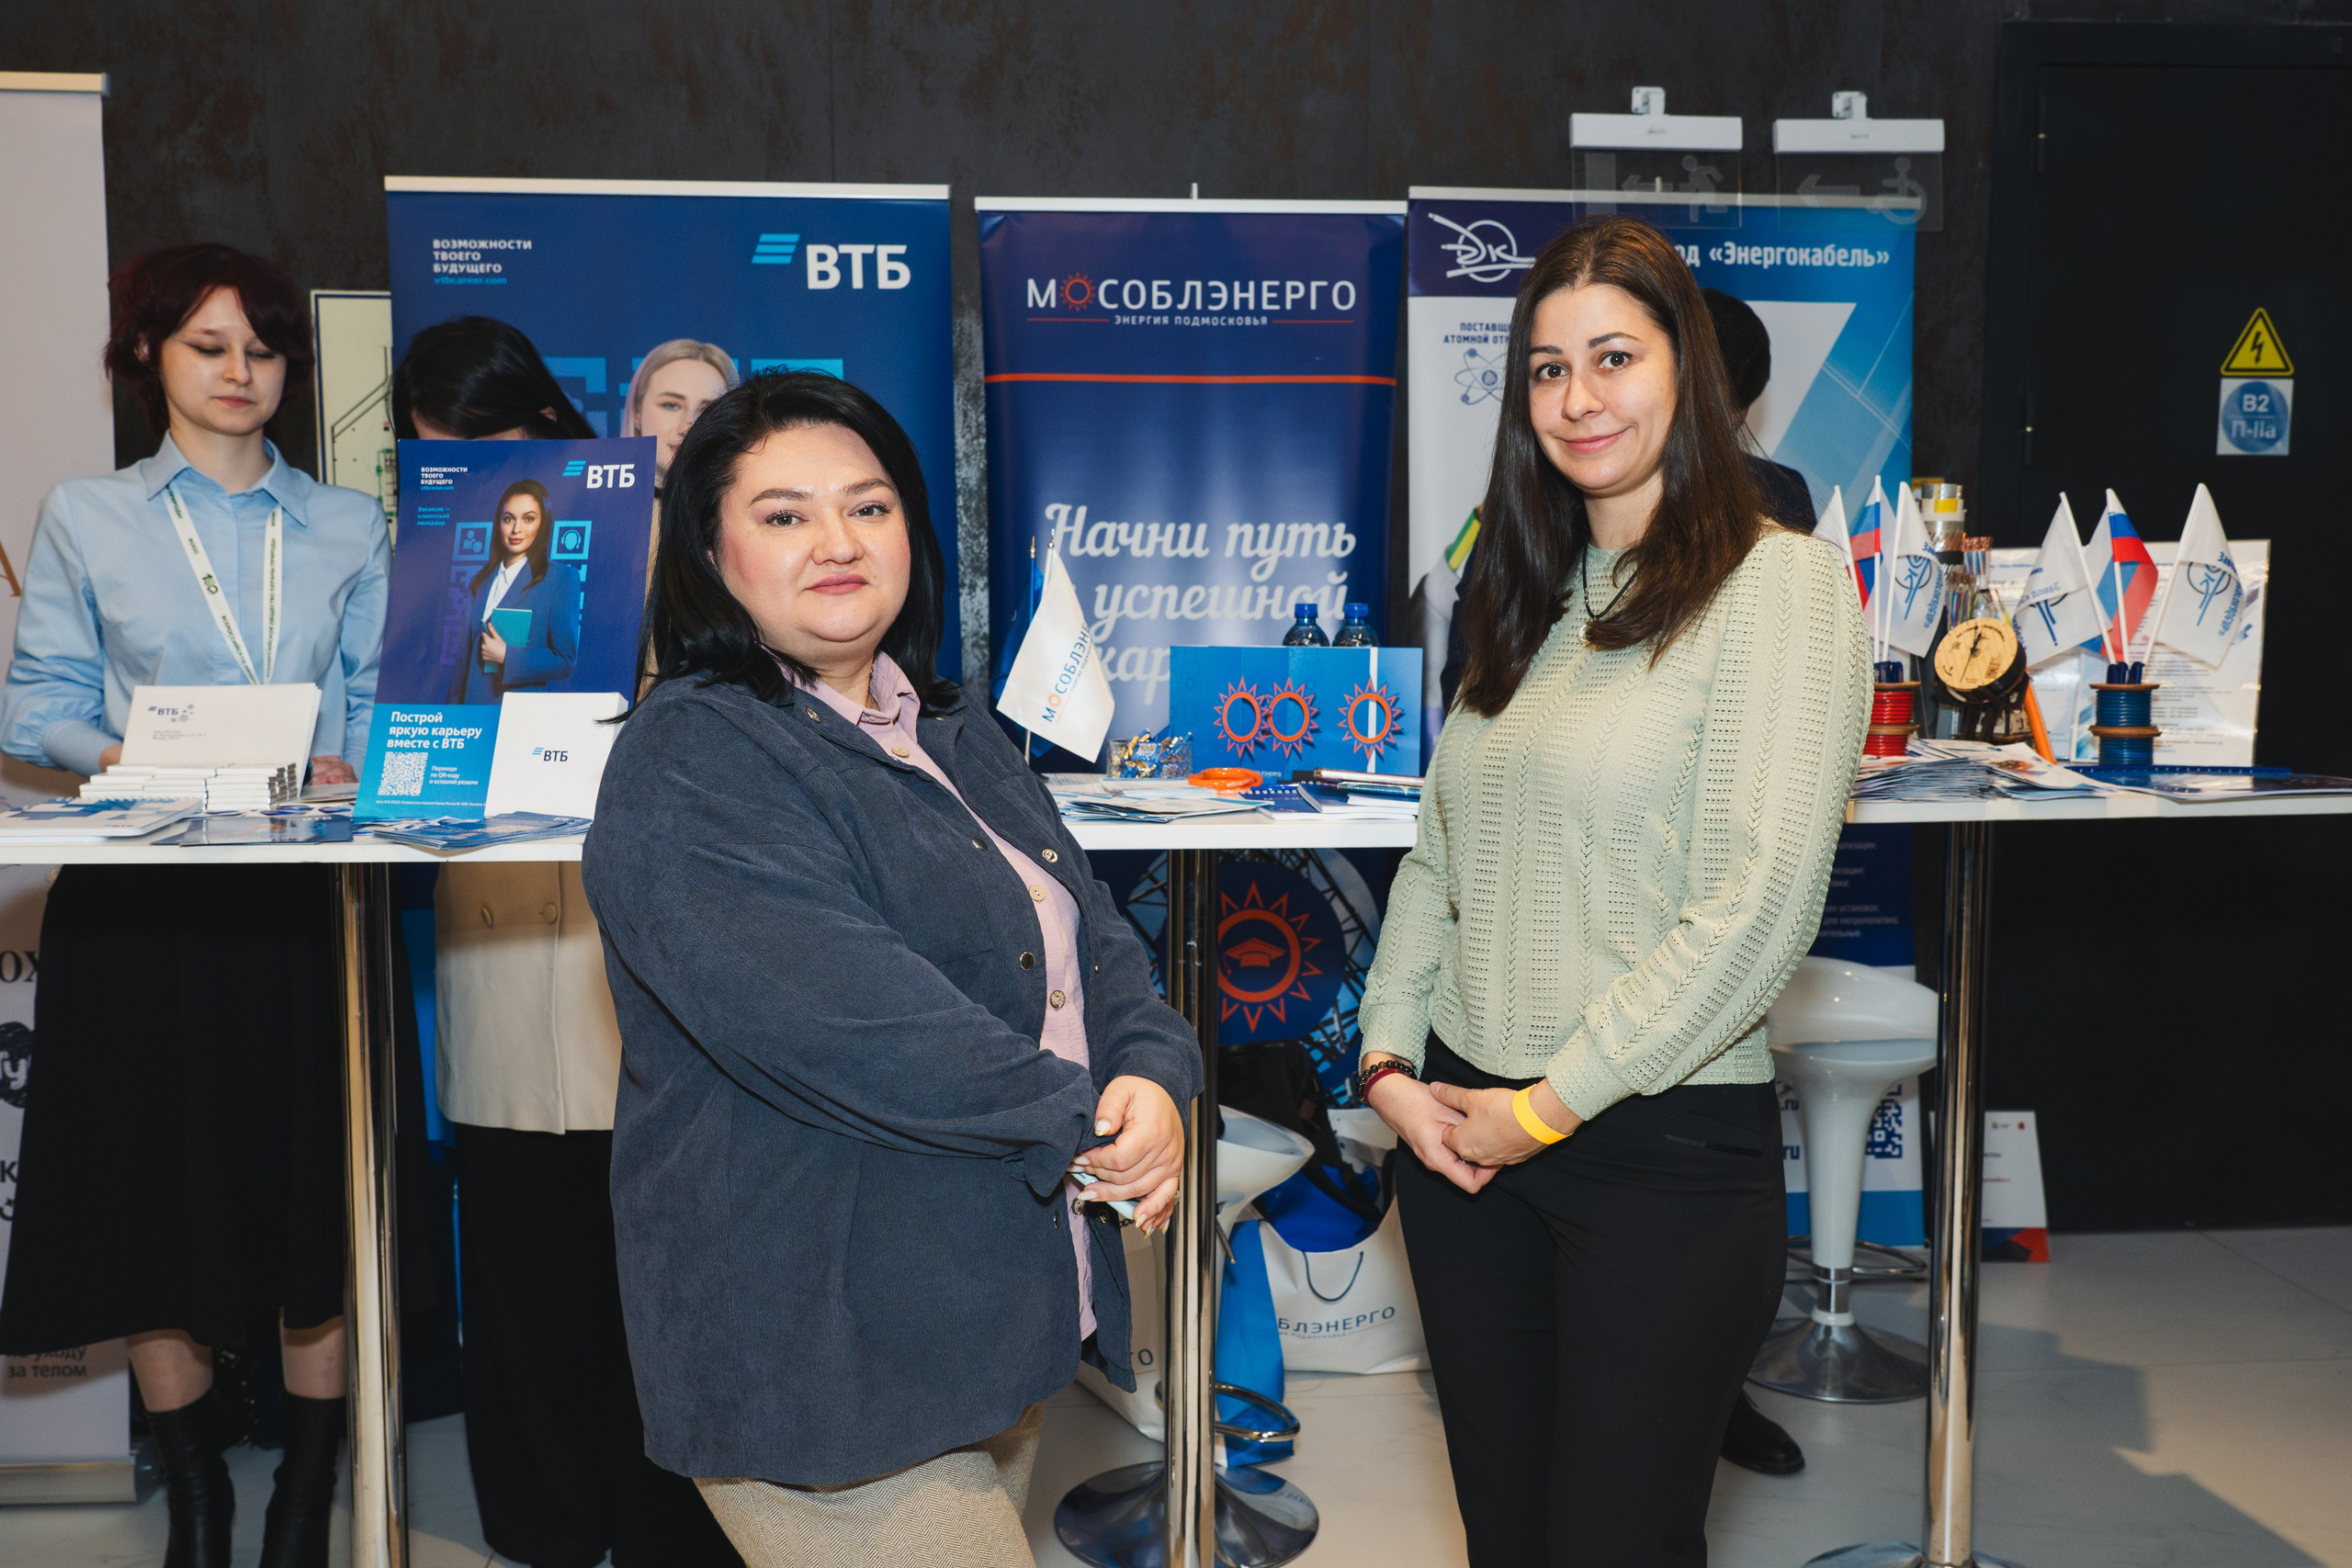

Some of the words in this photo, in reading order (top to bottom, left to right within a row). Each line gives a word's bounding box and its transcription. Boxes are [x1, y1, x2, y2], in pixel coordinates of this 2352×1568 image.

[433, 239, 532, 250] ВОЗМОЖНОСТИ
[433, 251, 481, 262] ТВОЕГО
[1709, 241, 1890, 269] «Энергокабель»
[433, 263, 503, 275] БУДУЩЕГО
[807, 244, 911, 289] ВТБ
[434, 276, 508, 286] vtbcareer.com
[1027, 273, 1356, 312] МОСОБЛЭНЕРГО
[1114, 314, 1170, 326] ЭНЕРГИЯ
[1174, 315, 1268, 328] ПОДМОСКОВЬЯ
[1443, 334, 1489, 344] АТОМНОЙ
[586, 464, 635, 489] ВТБ
[1045, 502, 1210, 558] Начни
[1224, 521, 1356, 582] путь
[157, 707, 178, 716] ВТБ
[390, 711, 443, 726] Построй
[389, 726, 429, 739] яркую
[431, 727, 482, 739] карьеру
[387, 739, 430, 749] вместе
[433, 739, 439, 749] с
[441, 738, 465, 750] ВТБ
[543, 750, 569, 762] ВТБ
[438, 772, 460, 780] QR-коду
[7, 1365, 27, 1377] за
[31, 1365, 87, 1378] телом
